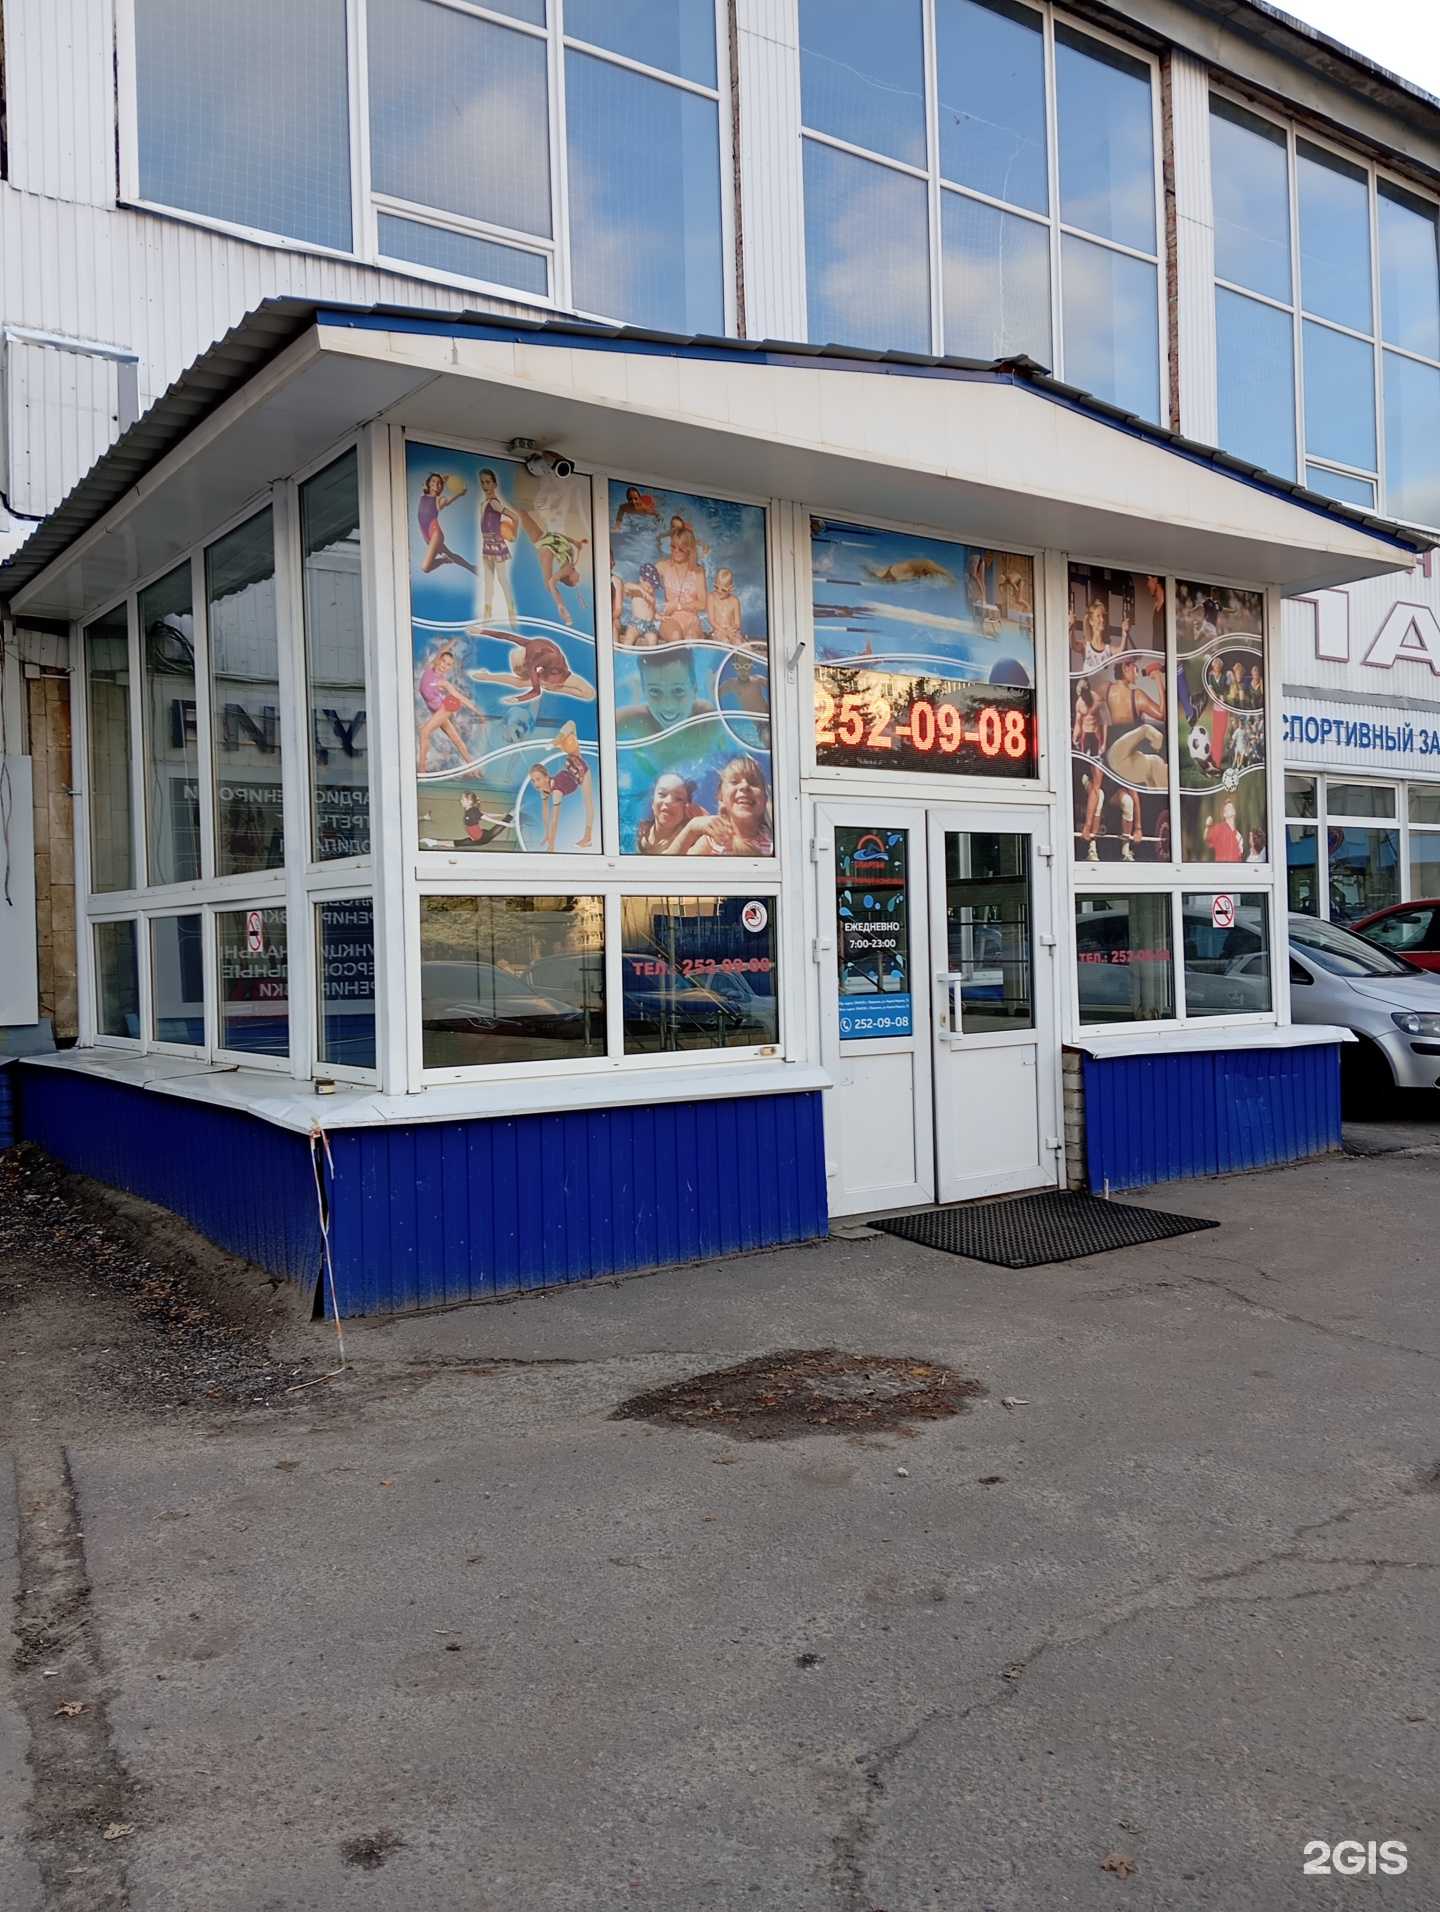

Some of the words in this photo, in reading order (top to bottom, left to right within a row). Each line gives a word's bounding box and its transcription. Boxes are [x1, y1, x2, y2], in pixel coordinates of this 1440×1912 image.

[815, 692, 1027, 758] 252-09-08
[844, 922, 900, 932] ЕЖЕДНЕВНО
[850, 939, 896, 948] 7:00-23:00
[854, 1017, 909, 1030] 252-09-08
